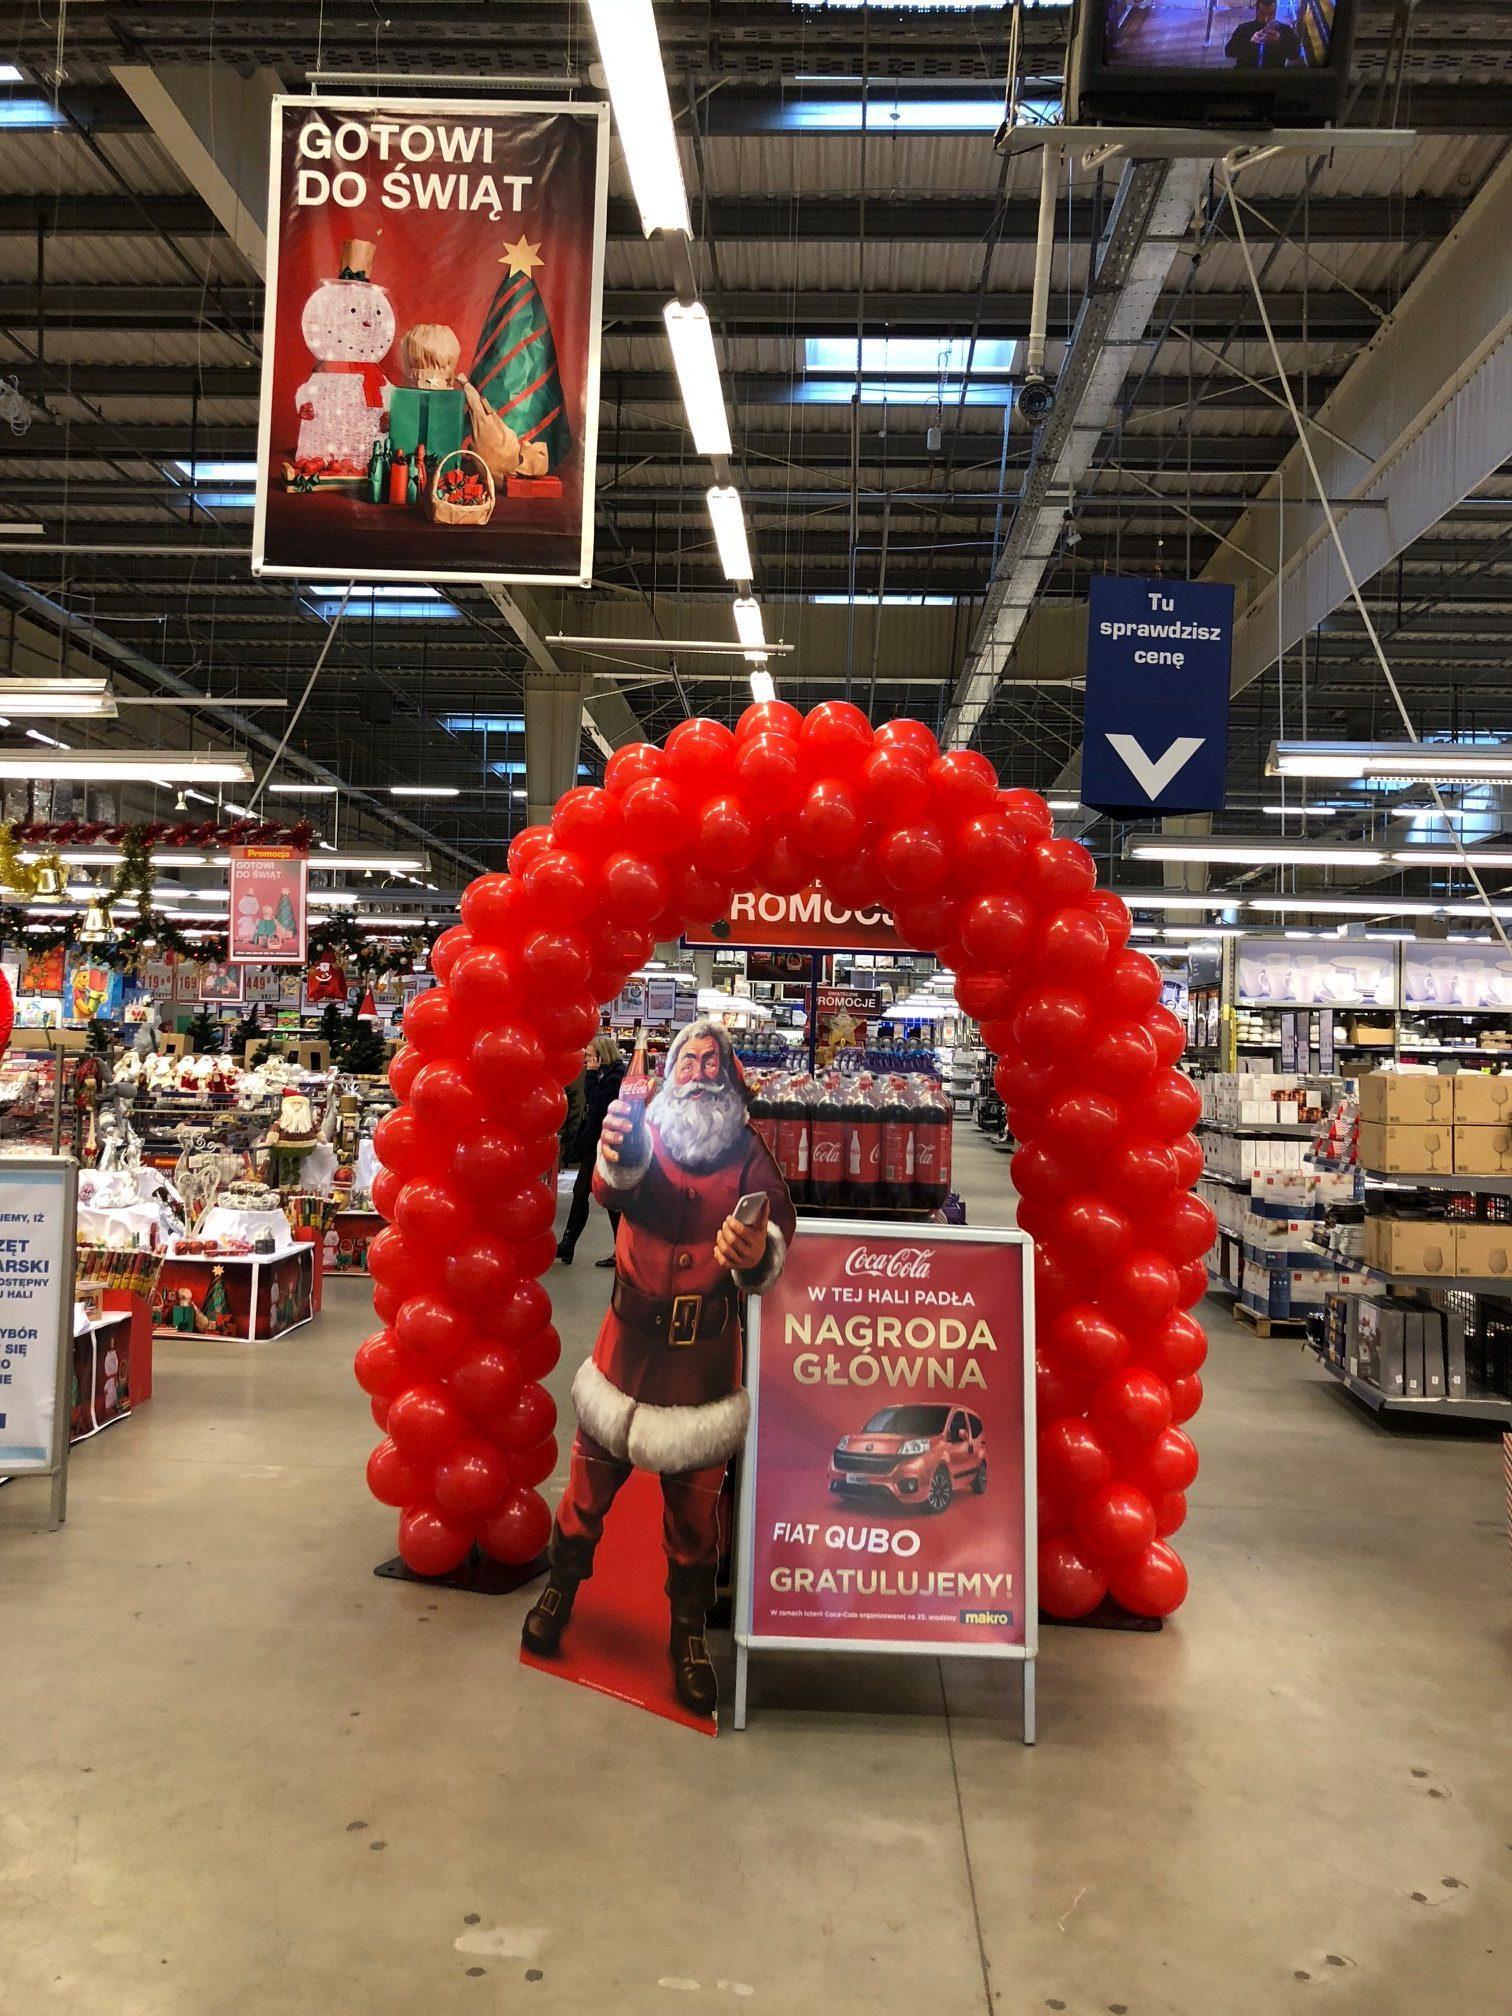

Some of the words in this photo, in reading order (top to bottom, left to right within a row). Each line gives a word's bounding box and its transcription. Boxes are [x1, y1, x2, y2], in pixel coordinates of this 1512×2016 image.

[299, 122, 493, 164] GOTOWI
[298, 170, 367, 208] DO
[381, 163, 533, 221] ŚWIĄT
[1148, 593, 1175, 612] Tu
[1100, 621, 1221, 641] sprawdzisz
[1134, 650, 1185, 669] cenę
[247, 849, 290, 859] Promocja
[236, 861, 275, 870] GOTOWI
[236, 870, 250, 879] DO
[252, 869, 282, 880] ŚWIĄT
[817, 996, 876, 1008] ROMOCJE
[845, 1246, 935, 1279] Coca-Cola
[7, 1290, 33, 1299] HALI
[808, 1286, 826, 1302] W
[832, 1287, 863, 1303] TEJ
[868, 1289, 909, 1305] HALI
[915, 1290, 976, 1307] PADŁA
[784, 1313, 998, 1351] NAGRODA
[5, 1344, 28, 1357] SIĘ
[793, 1346, 988, 1389] GŁÓWNA
[773, 1522, 819, 1545] FIAT
[825, 1525, 921, 1557] QUBO
[769, 1566, 1013, 1598] GRATULUJEMY!
[965, 1611, 1008, 1625] makro
